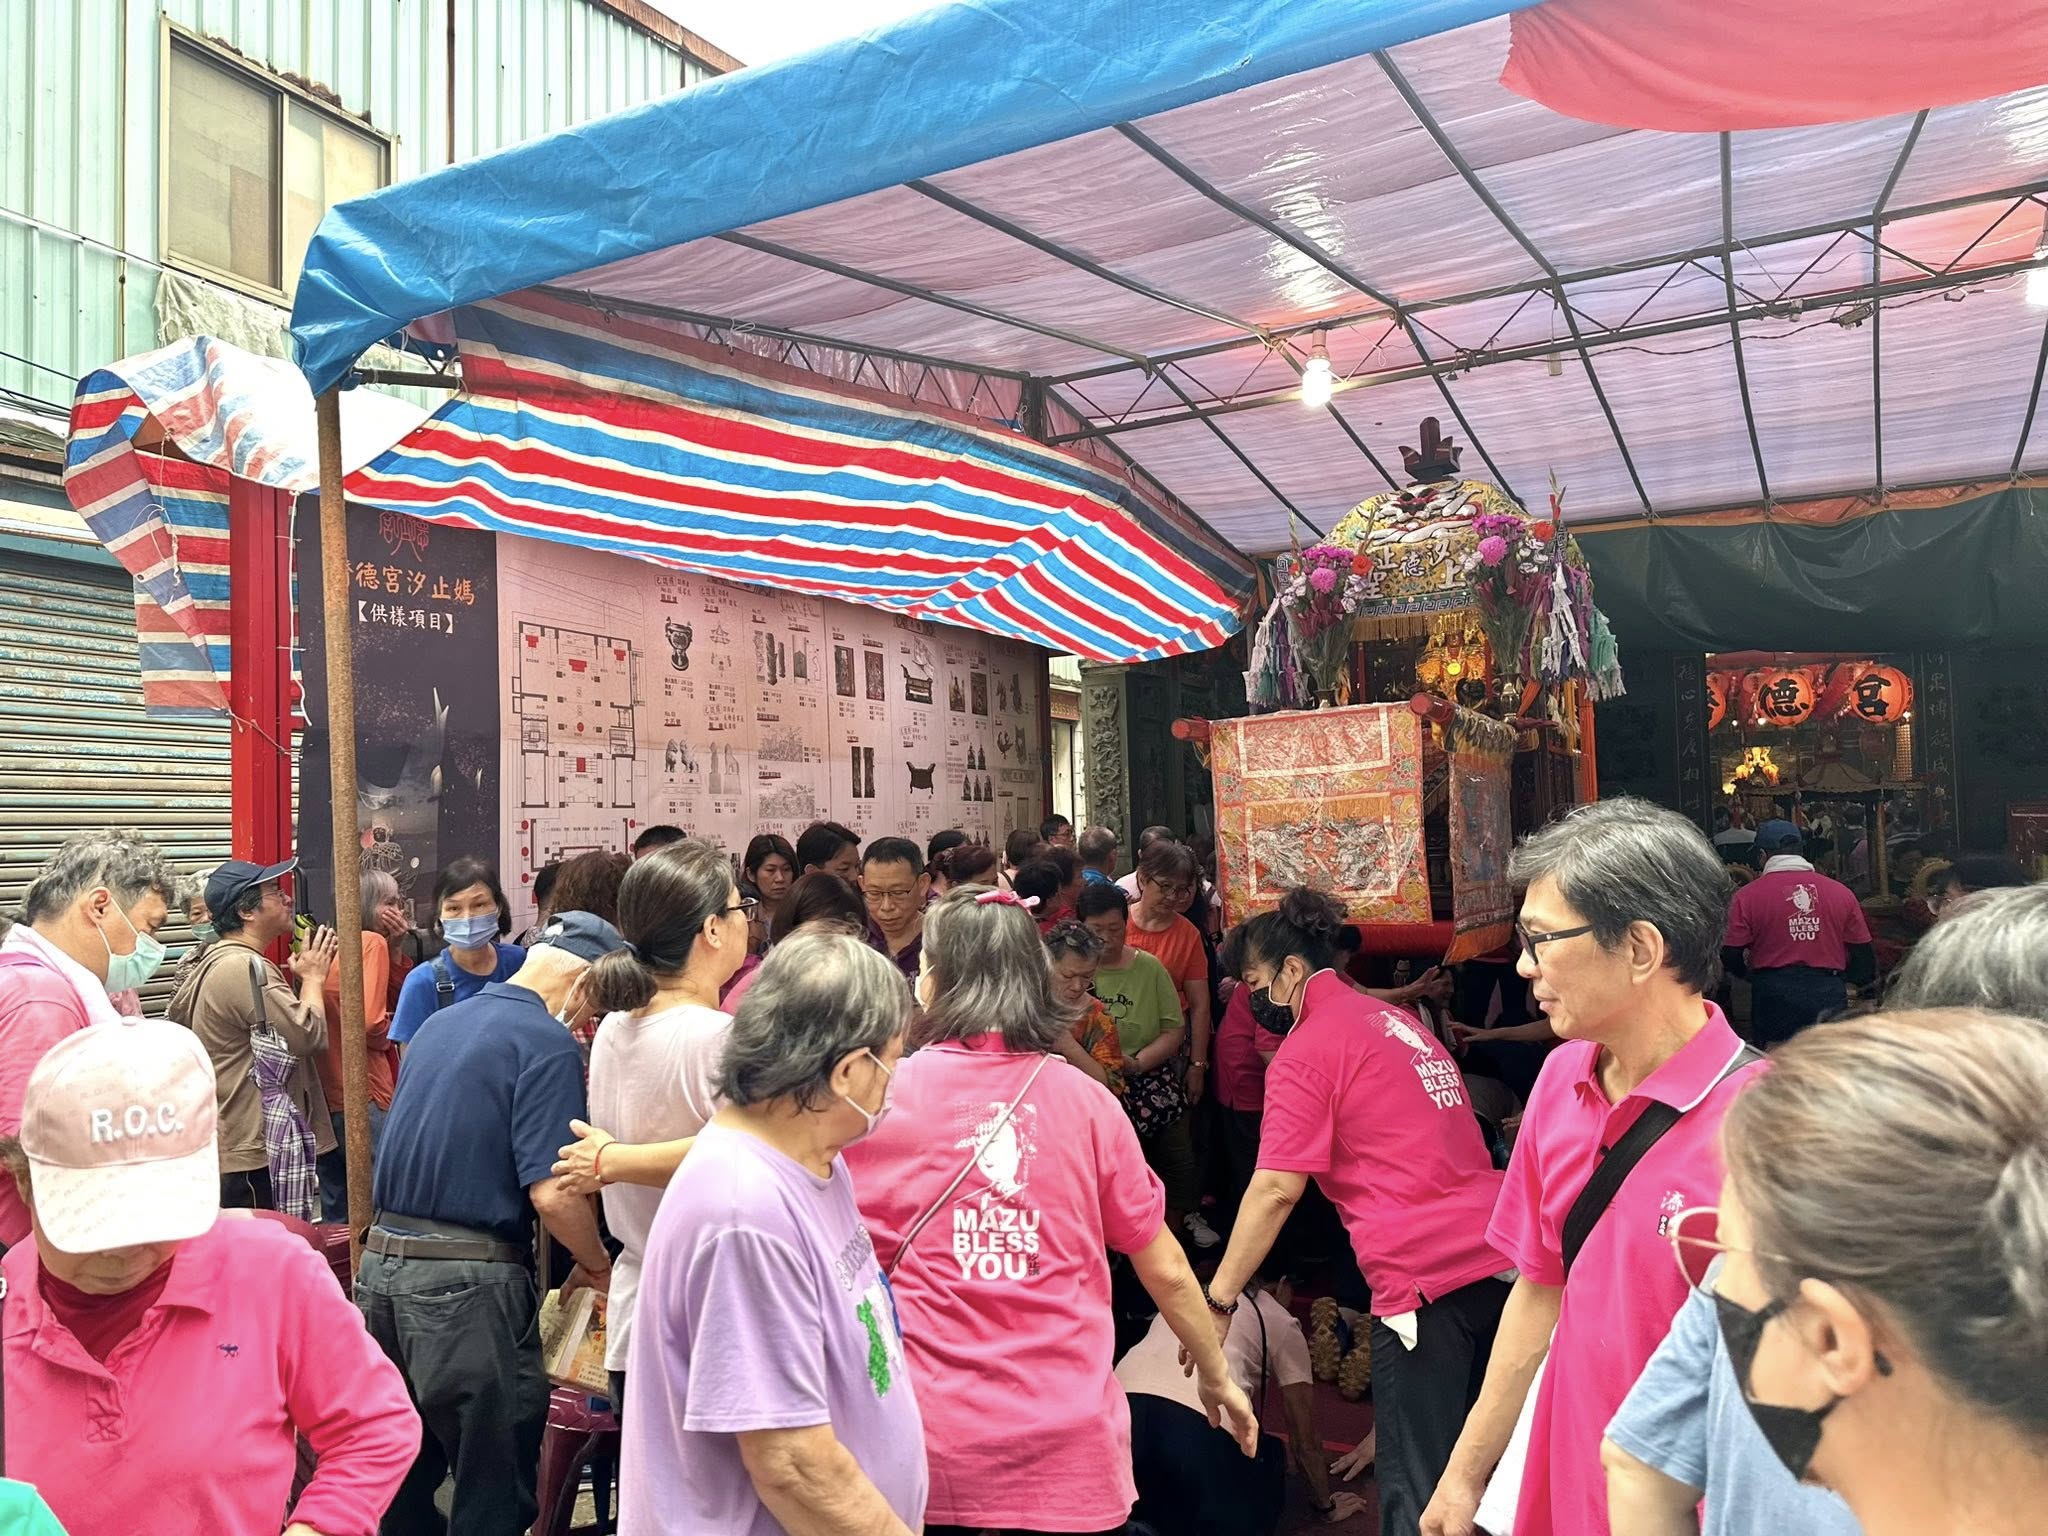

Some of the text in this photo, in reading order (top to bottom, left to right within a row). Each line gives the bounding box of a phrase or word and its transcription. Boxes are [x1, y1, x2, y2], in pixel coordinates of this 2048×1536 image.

[1757, 677, 1810, 718] 德
[1852, 673, 1892, 718] 宮
[1788, 917, 1820, 926] MAZU
[1789, 925, 1820, 933] BLESS
[1791, 932, 1816, 941] YOU
[1414, 1059, 1455, 1079] MAZU
[1422, 1073, 1460, 1093] BLESS
[1429, 1088, 1463, 1110] YOU
[90, 1102, 185, 1143] R.O.C.
[953, 1208, 1040, 1232] MAZU
[953, 1231, 1040, 1254] BLESS
[953, 1253, 1028, 1281] YOU
